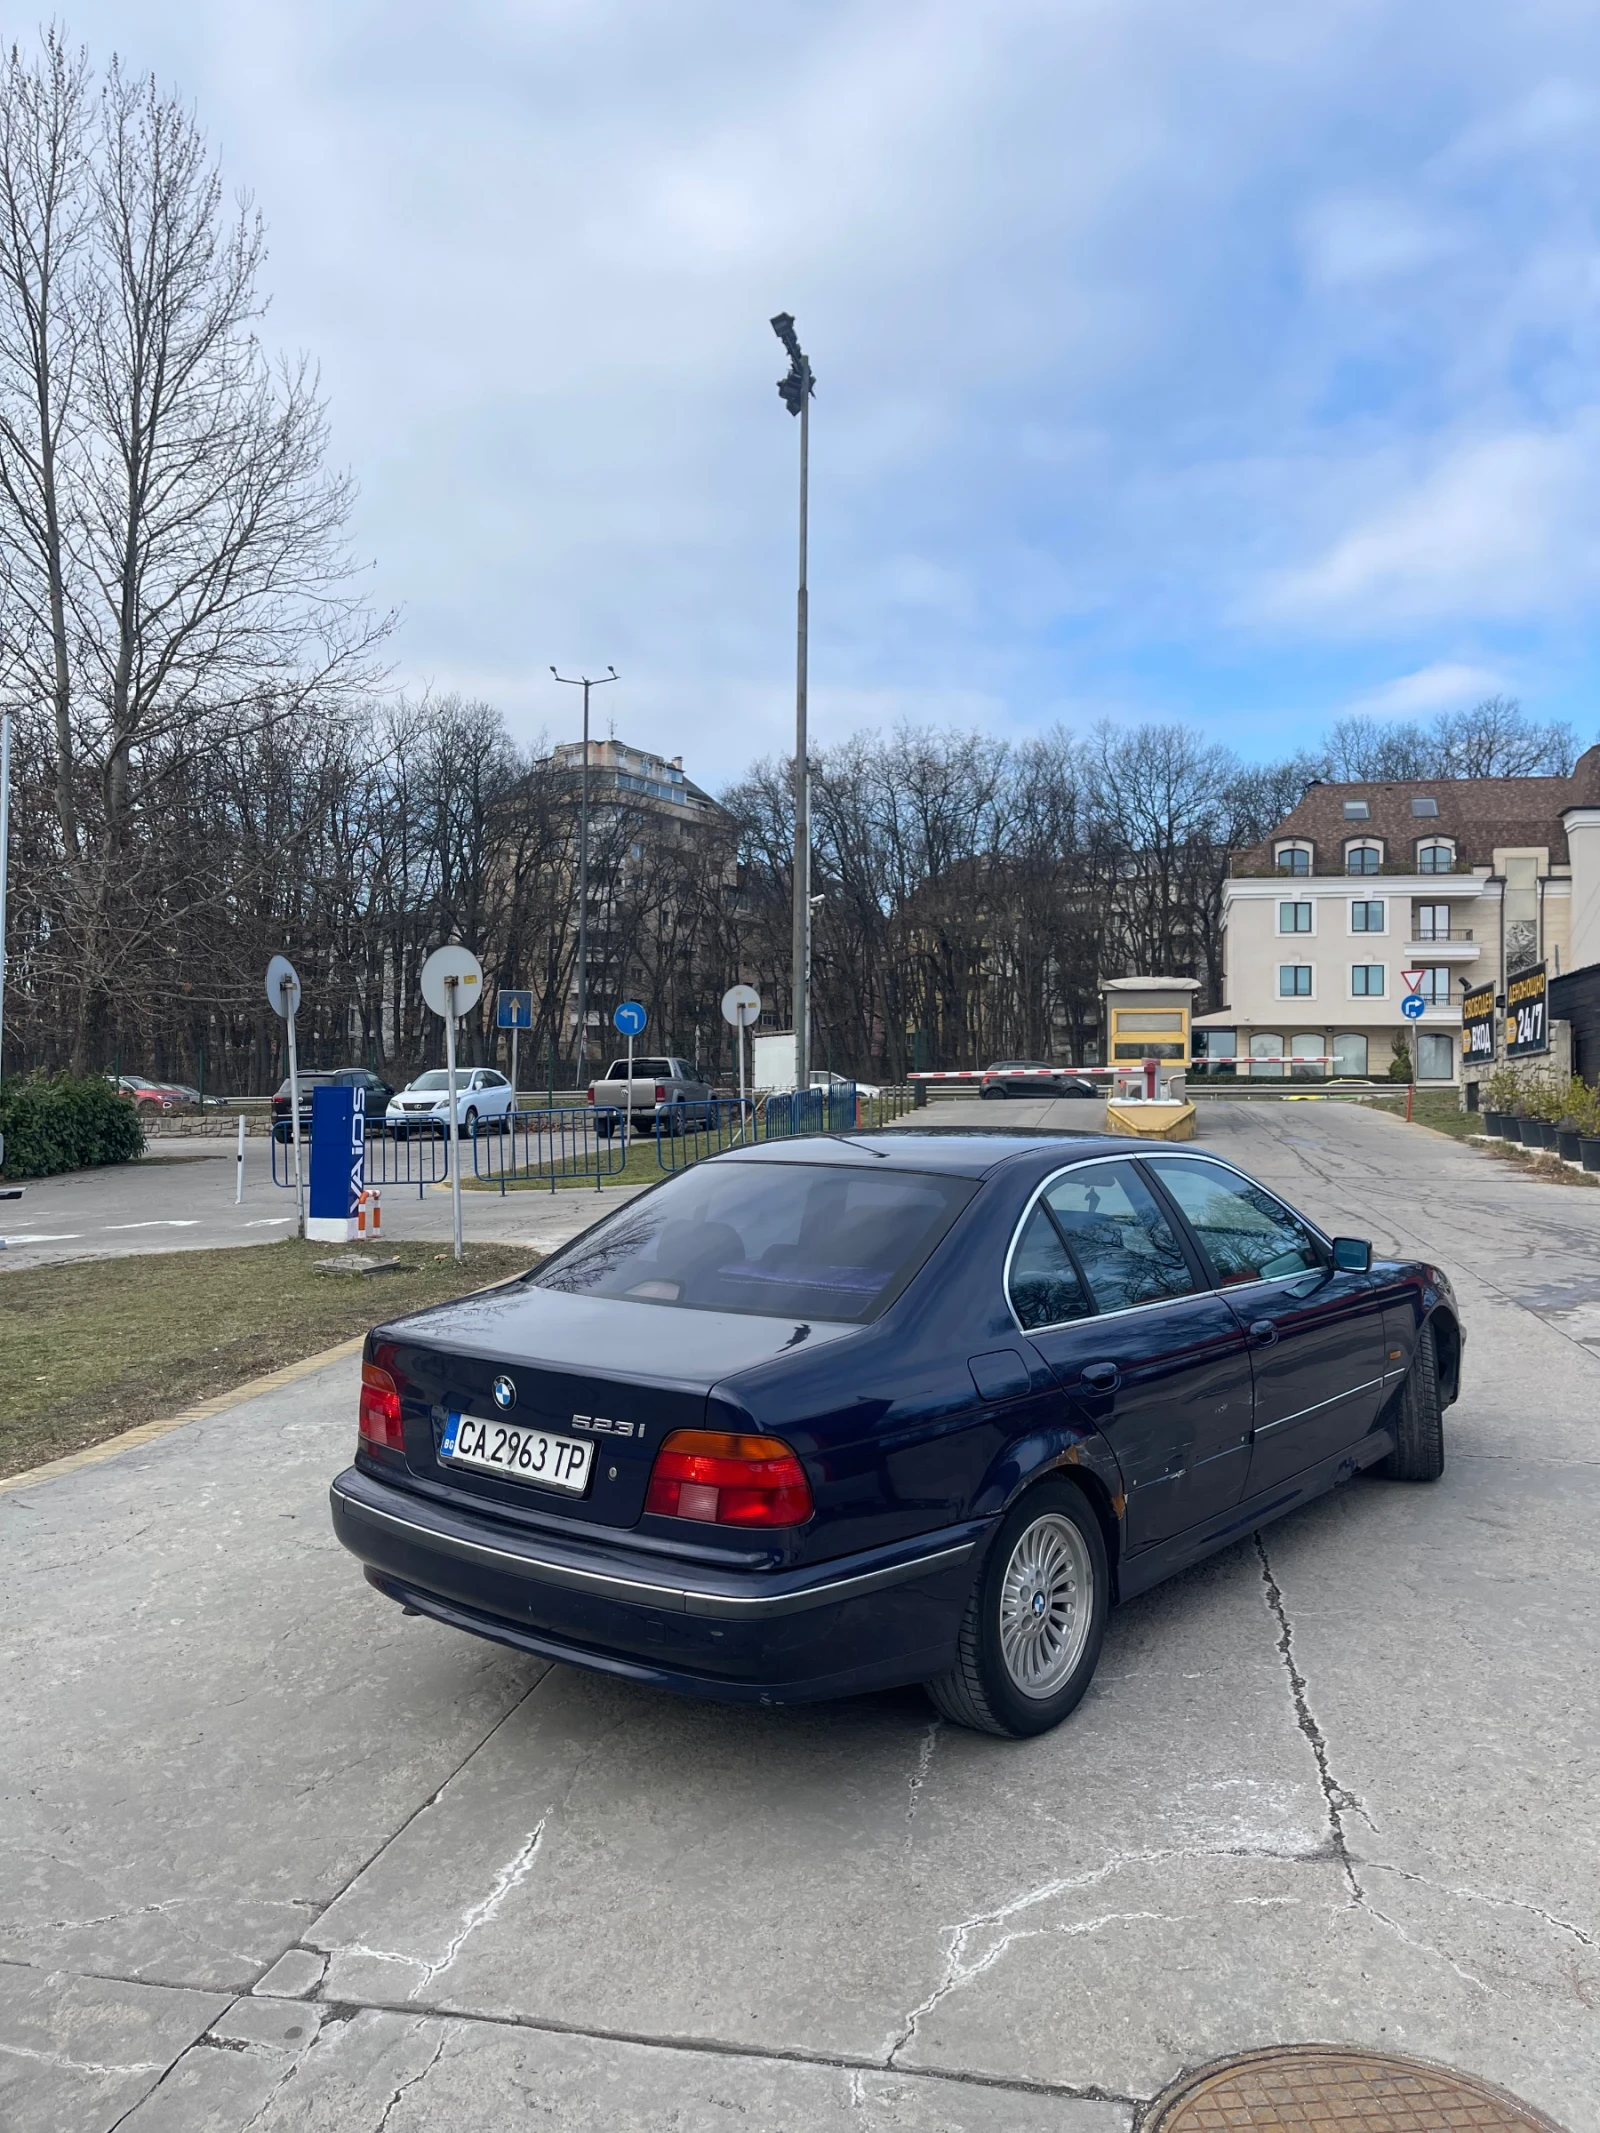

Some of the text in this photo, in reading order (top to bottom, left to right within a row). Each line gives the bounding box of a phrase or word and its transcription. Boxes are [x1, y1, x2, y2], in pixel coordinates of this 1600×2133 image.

[1464, 990, 1494, 1020] СВОБОДЕН
[1508, 972, 1545, 1007] ДЕНОНОЩНО
[1471, 1022, 1492, 1054] ВХОД
[1517, 1002, 1544, 1044] 24/7
[571, 1414, 646, 1438] 523i
[444, 1438, 455, 1450] BG
